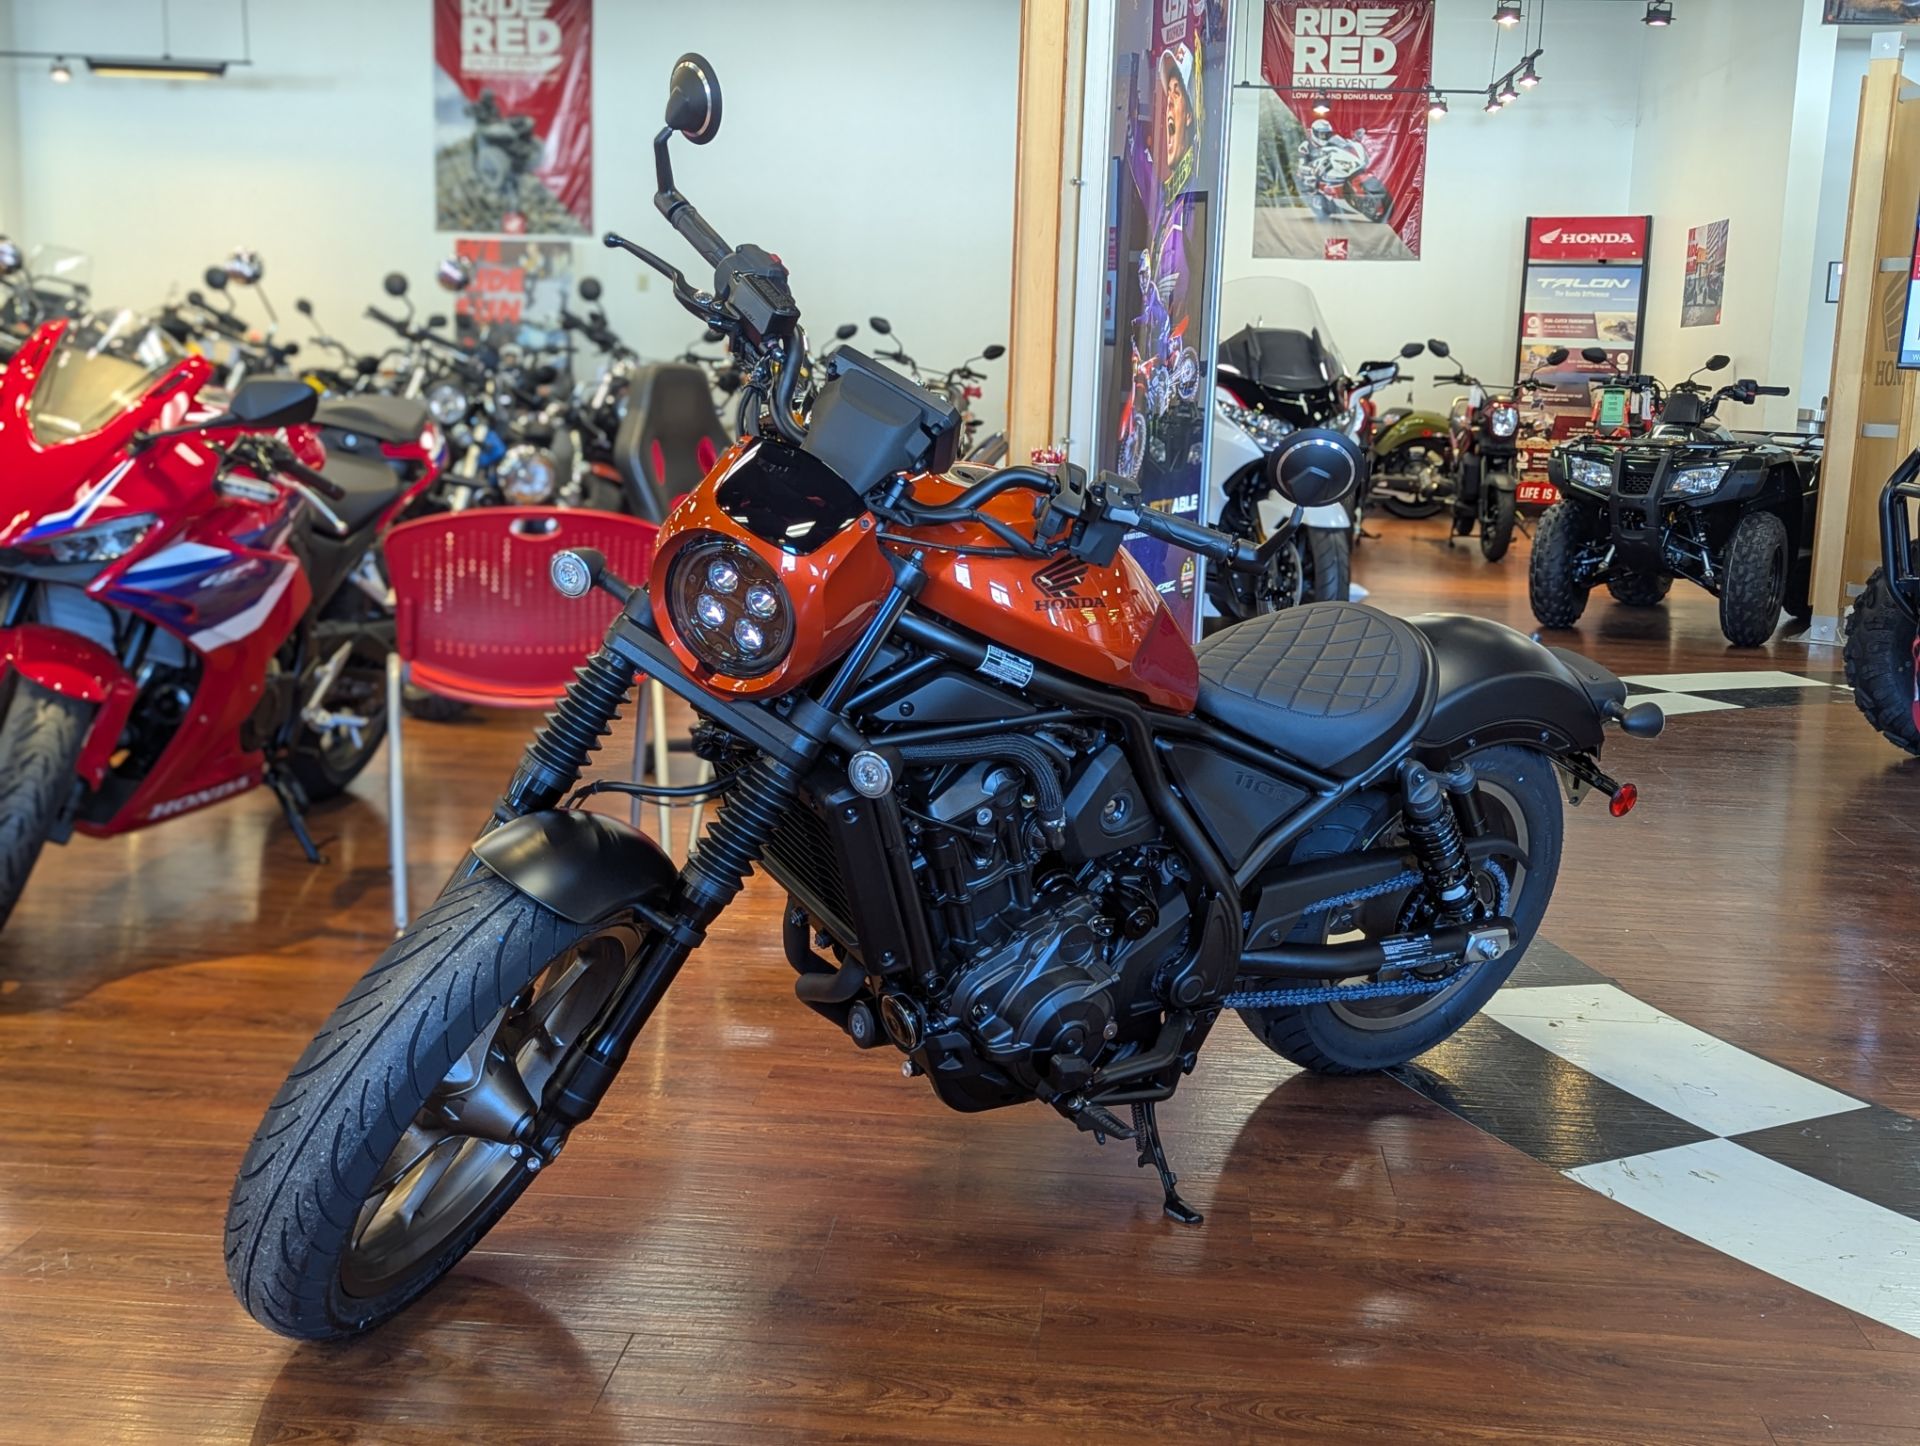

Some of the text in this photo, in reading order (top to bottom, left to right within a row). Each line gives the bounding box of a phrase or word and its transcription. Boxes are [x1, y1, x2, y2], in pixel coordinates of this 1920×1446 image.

[1295, 8, 1399, 36] RIDE
[461, 18, 562, 54] RED
[1293, 36, 1397, 74] RED
[1297, 76, 1378, 89] SALES EVENT
[1369, 93, 1393, 101] BUCKS
[1560, 233, 1635, 244] HONDA
[1537, 278, 1631, 289] TALON
[1520, 487, 1540, 499] LIFE
[1542, 488, 1553, 500] IS
[1034, 597, 1106, 611] HONDA
